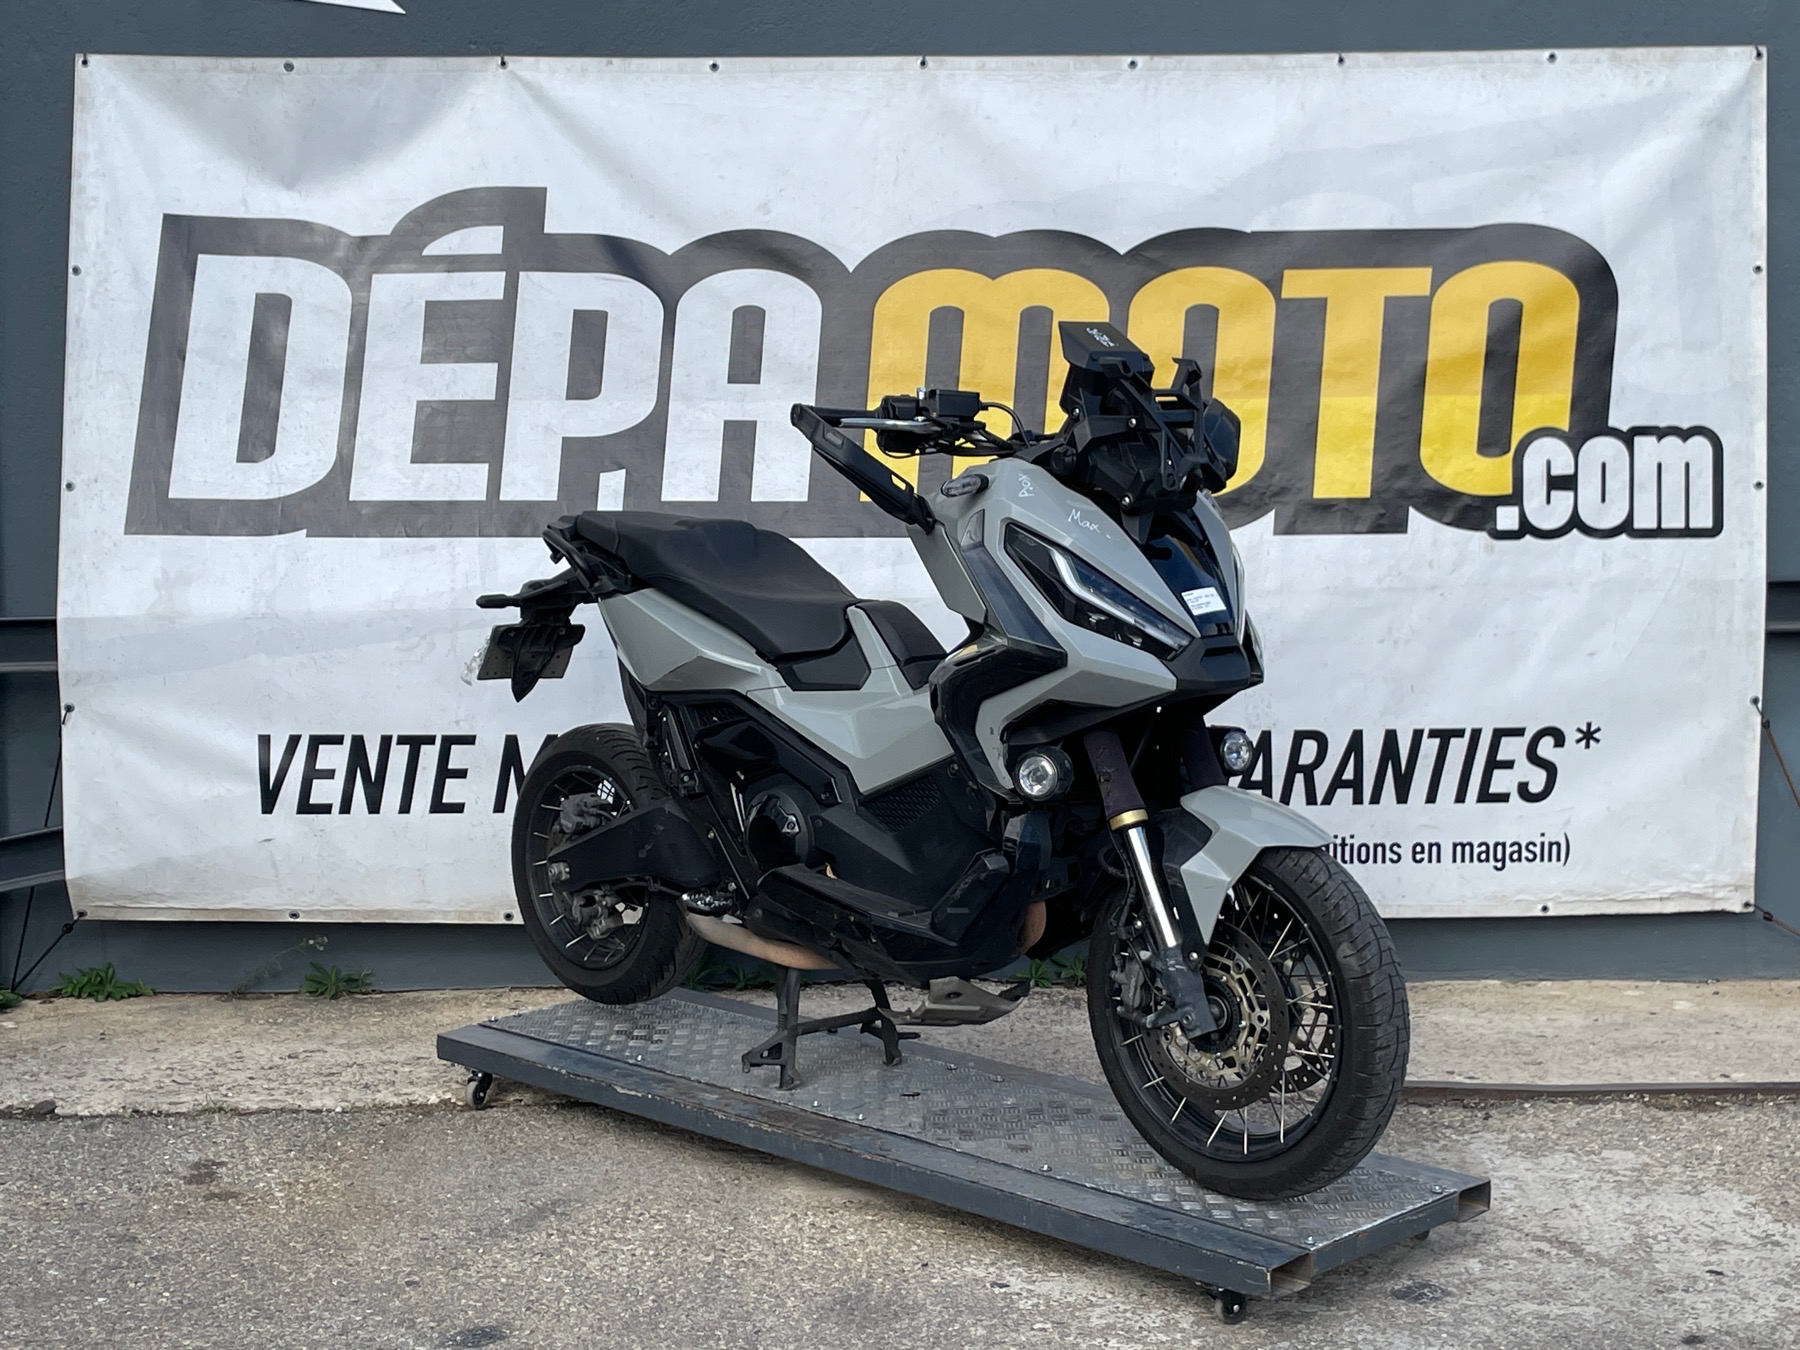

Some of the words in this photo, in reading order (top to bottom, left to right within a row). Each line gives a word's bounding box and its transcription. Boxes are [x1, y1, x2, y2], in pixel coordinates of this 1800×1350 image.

[257, 734, 477, 815] VENTE
[1237, 722, 1602, 806] ARANTIES
[1323, 834, 1402, 865] itions
[1411, 841, 1443, 864] en
[1451, 833, 1571, 872] magasin)
